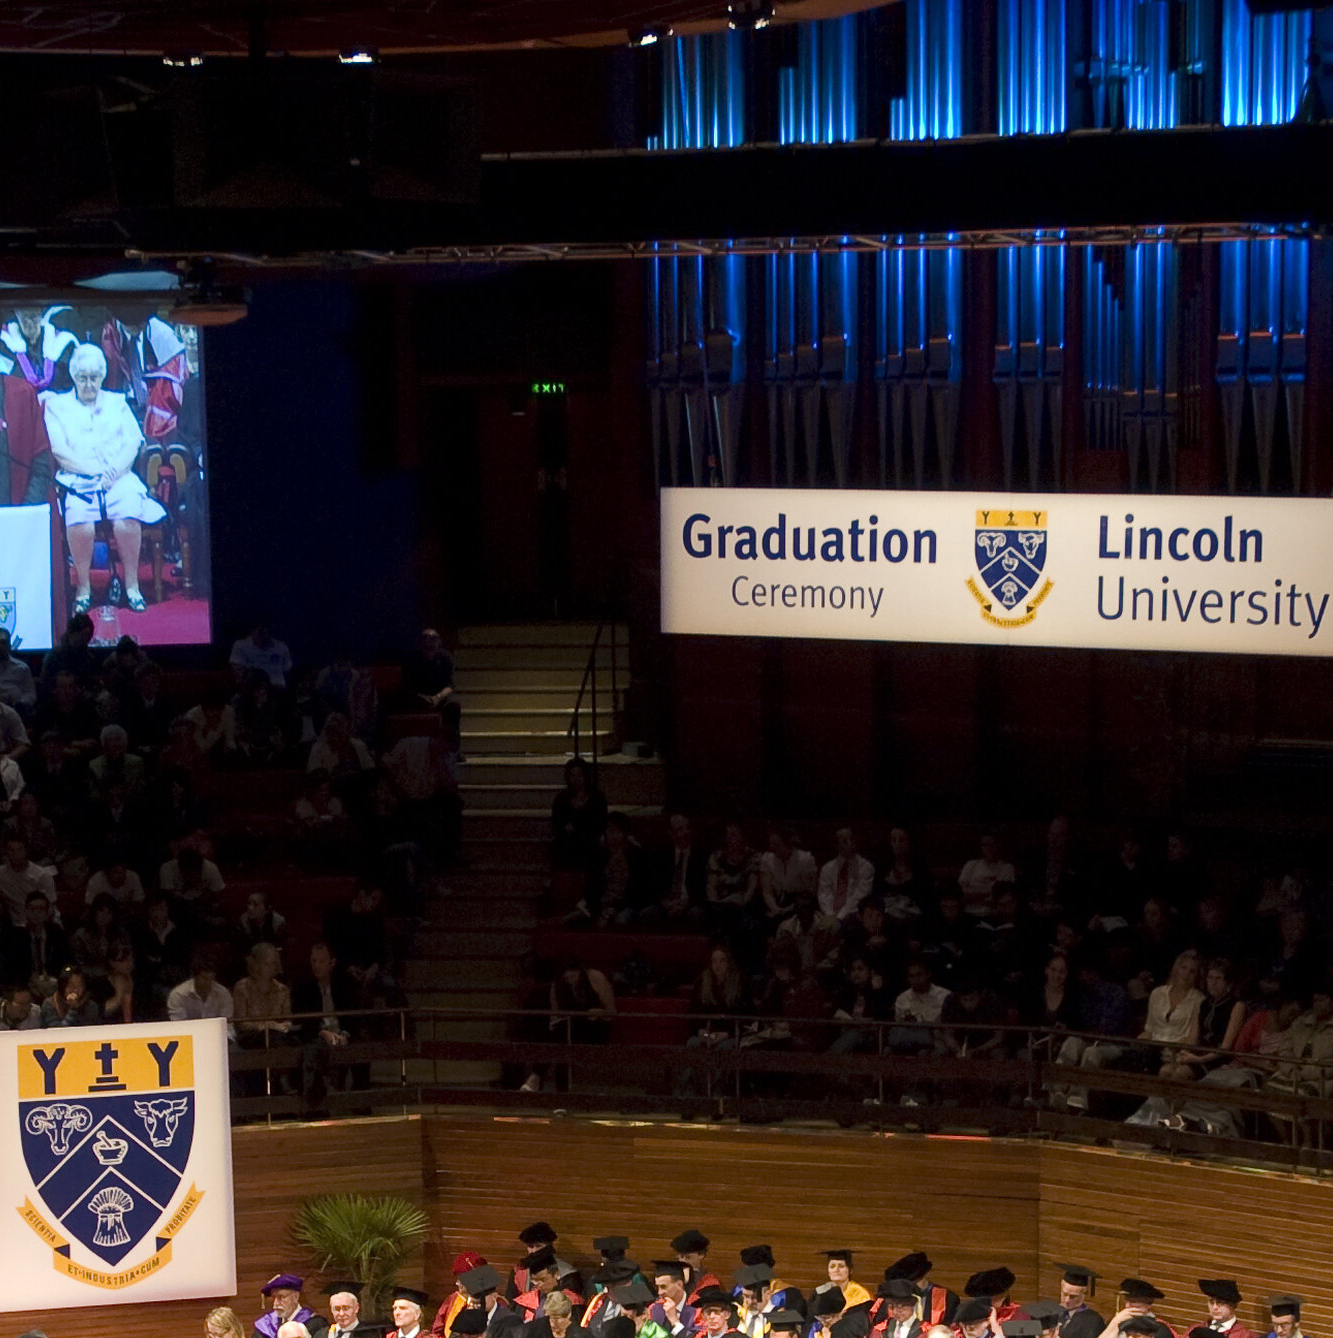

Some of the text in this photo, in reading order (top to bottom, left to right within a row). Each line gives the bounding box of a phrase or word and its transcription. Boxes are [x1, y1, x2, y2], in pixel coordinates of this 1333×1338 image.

[532, 383, 565, 393] EXIT
[681, 511, 938, 565] Graduation
[1097, 513, 1264, 564] Lincoln
[730, 574, 885, 618] Ceremony
[1096, 575, 1331, 640] University
[24, 1208, 57, 1243] SCIENTIA
